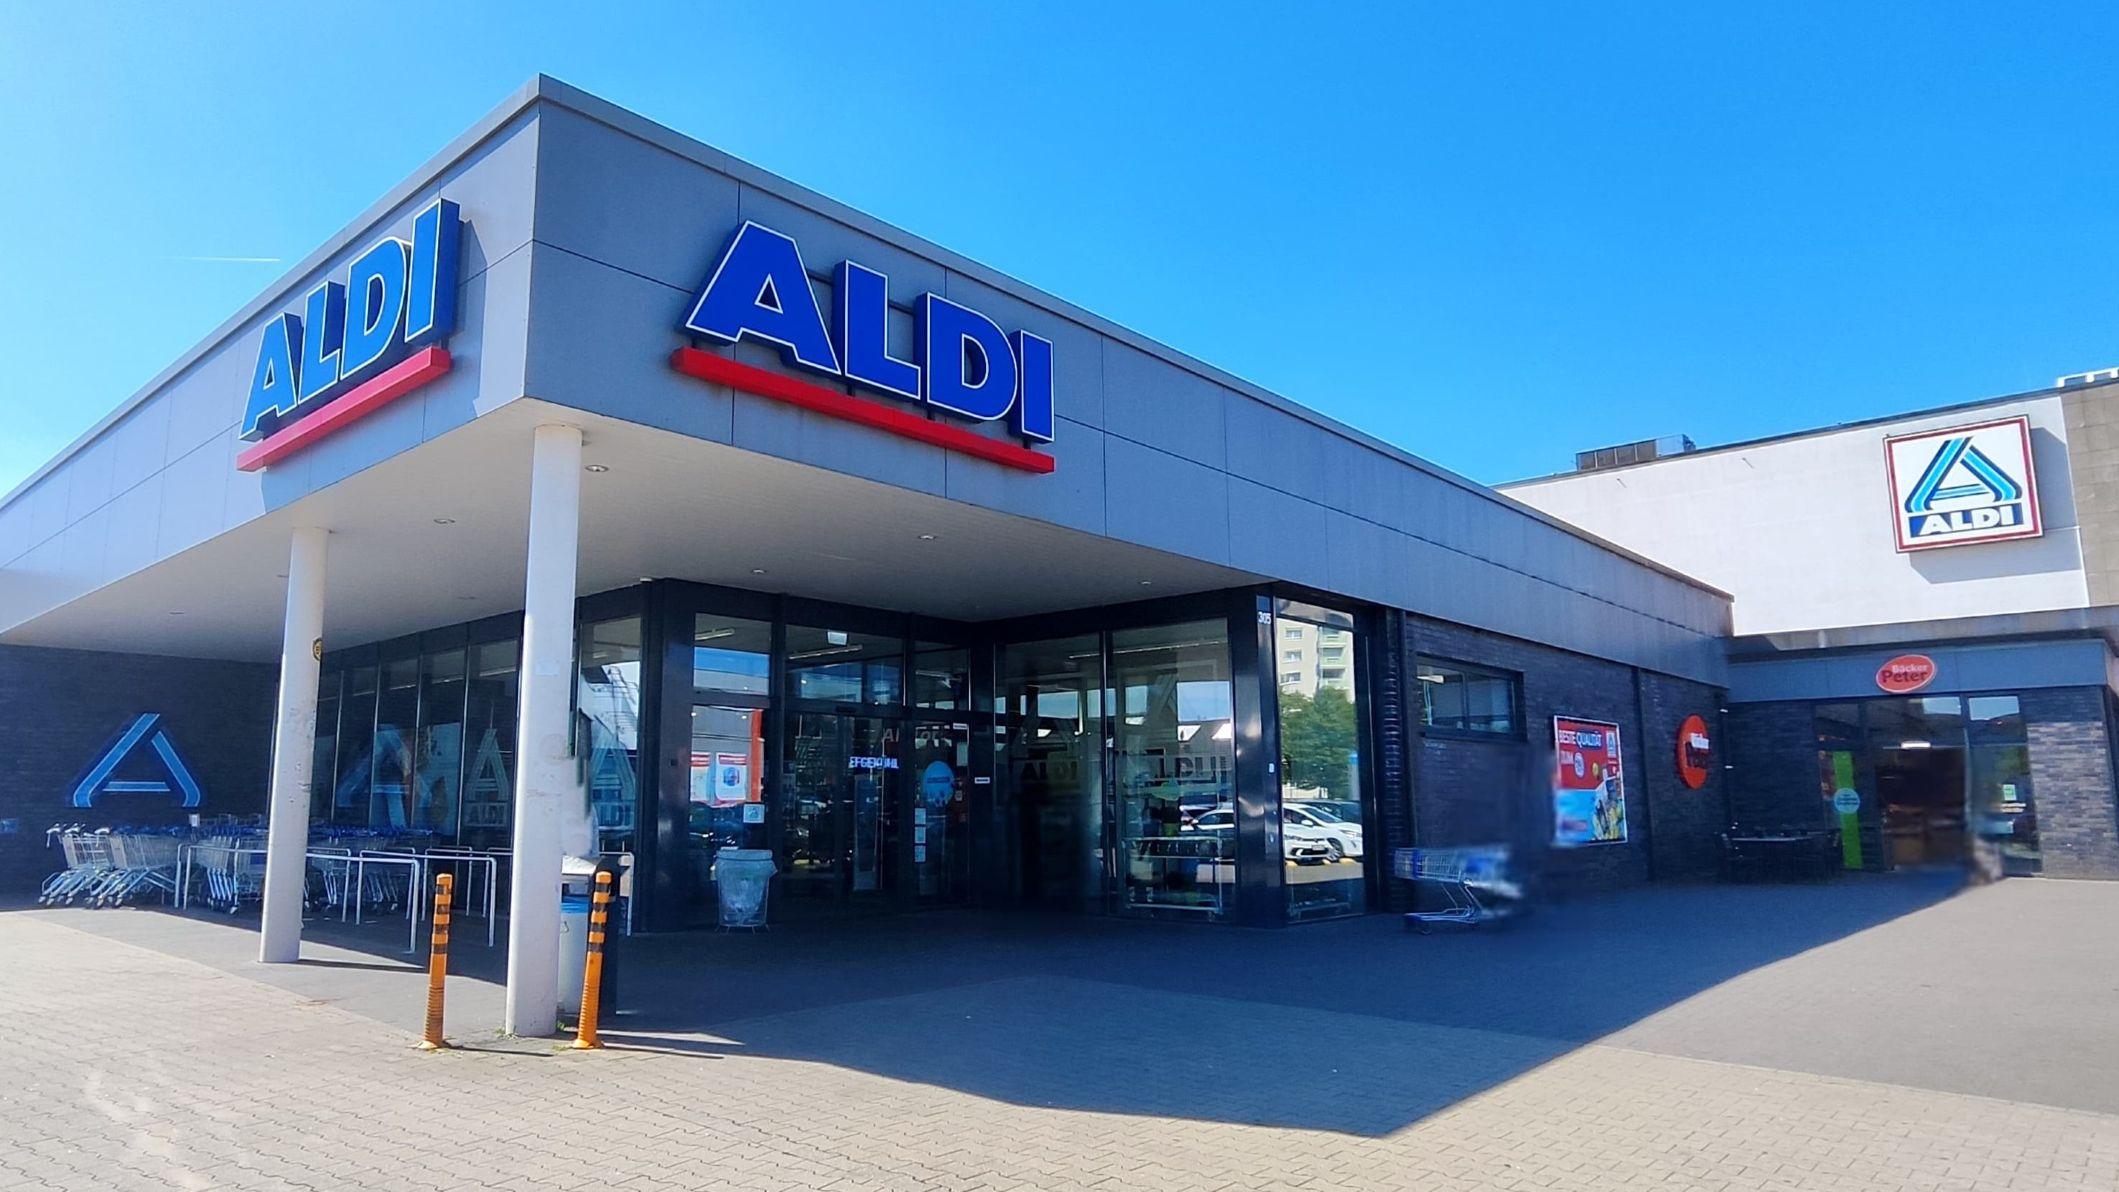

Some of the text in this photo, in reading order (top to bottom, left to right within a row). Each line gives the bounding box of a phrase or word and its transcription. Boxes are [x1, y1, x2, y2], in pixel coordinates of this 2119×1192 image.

[239, 198, 445, 440] ALDI
[686, 220, 1054, 442] ALDI
[1919, 505, 2015, 536] ALDI
[1881, 670, 1928, 683] Peter
[1892, 664, 1928, 673] Bäcker
